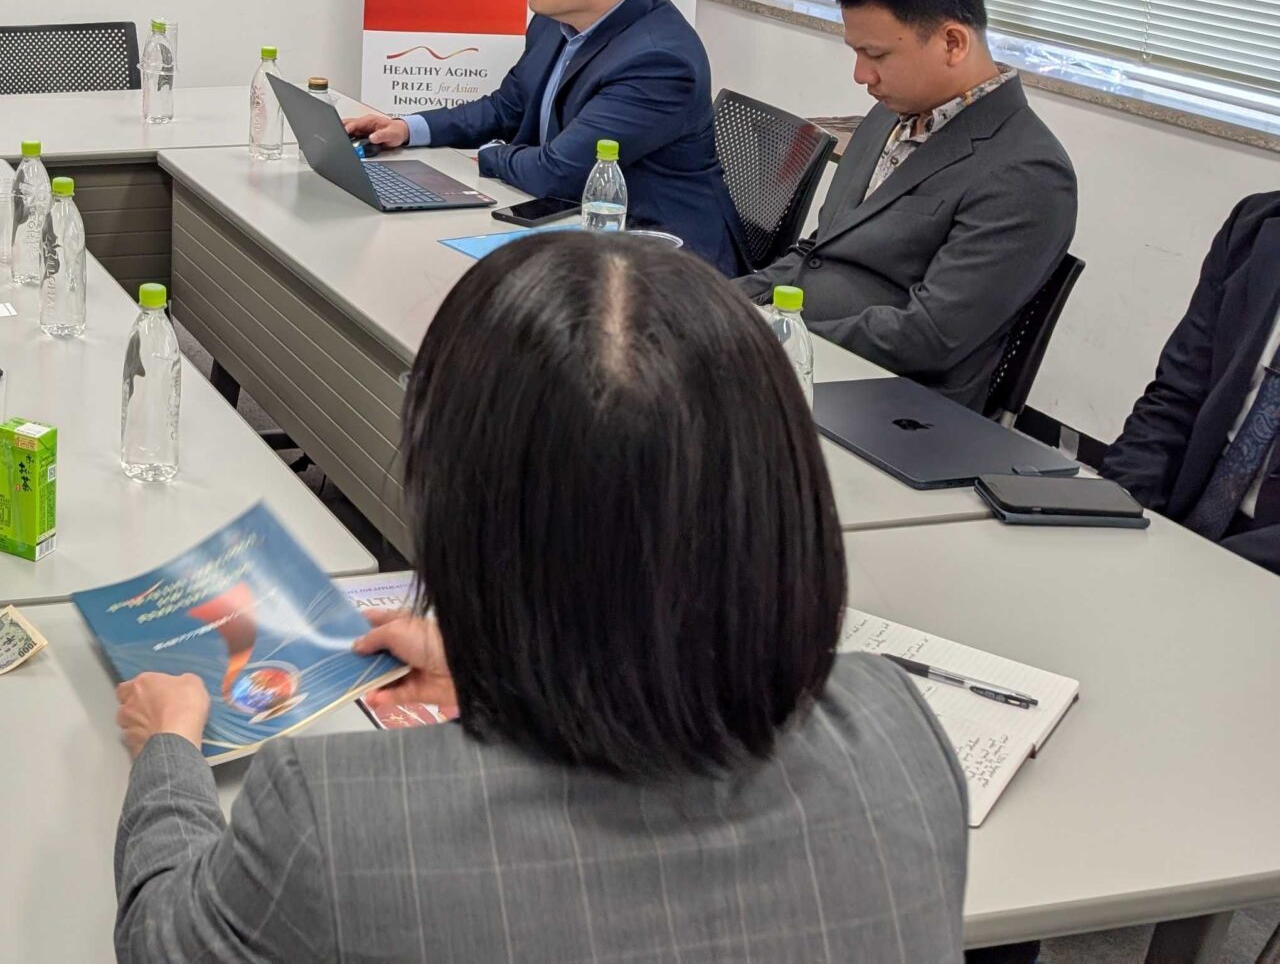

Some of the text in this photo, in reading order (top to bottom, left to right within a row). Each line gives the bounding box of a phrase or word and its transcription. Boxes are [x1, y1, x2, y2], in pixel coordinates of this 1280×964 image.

[383, 64, 488, 78] HEALTHY AGING
[392, 80, 479, 94] PRIZE for Asian
